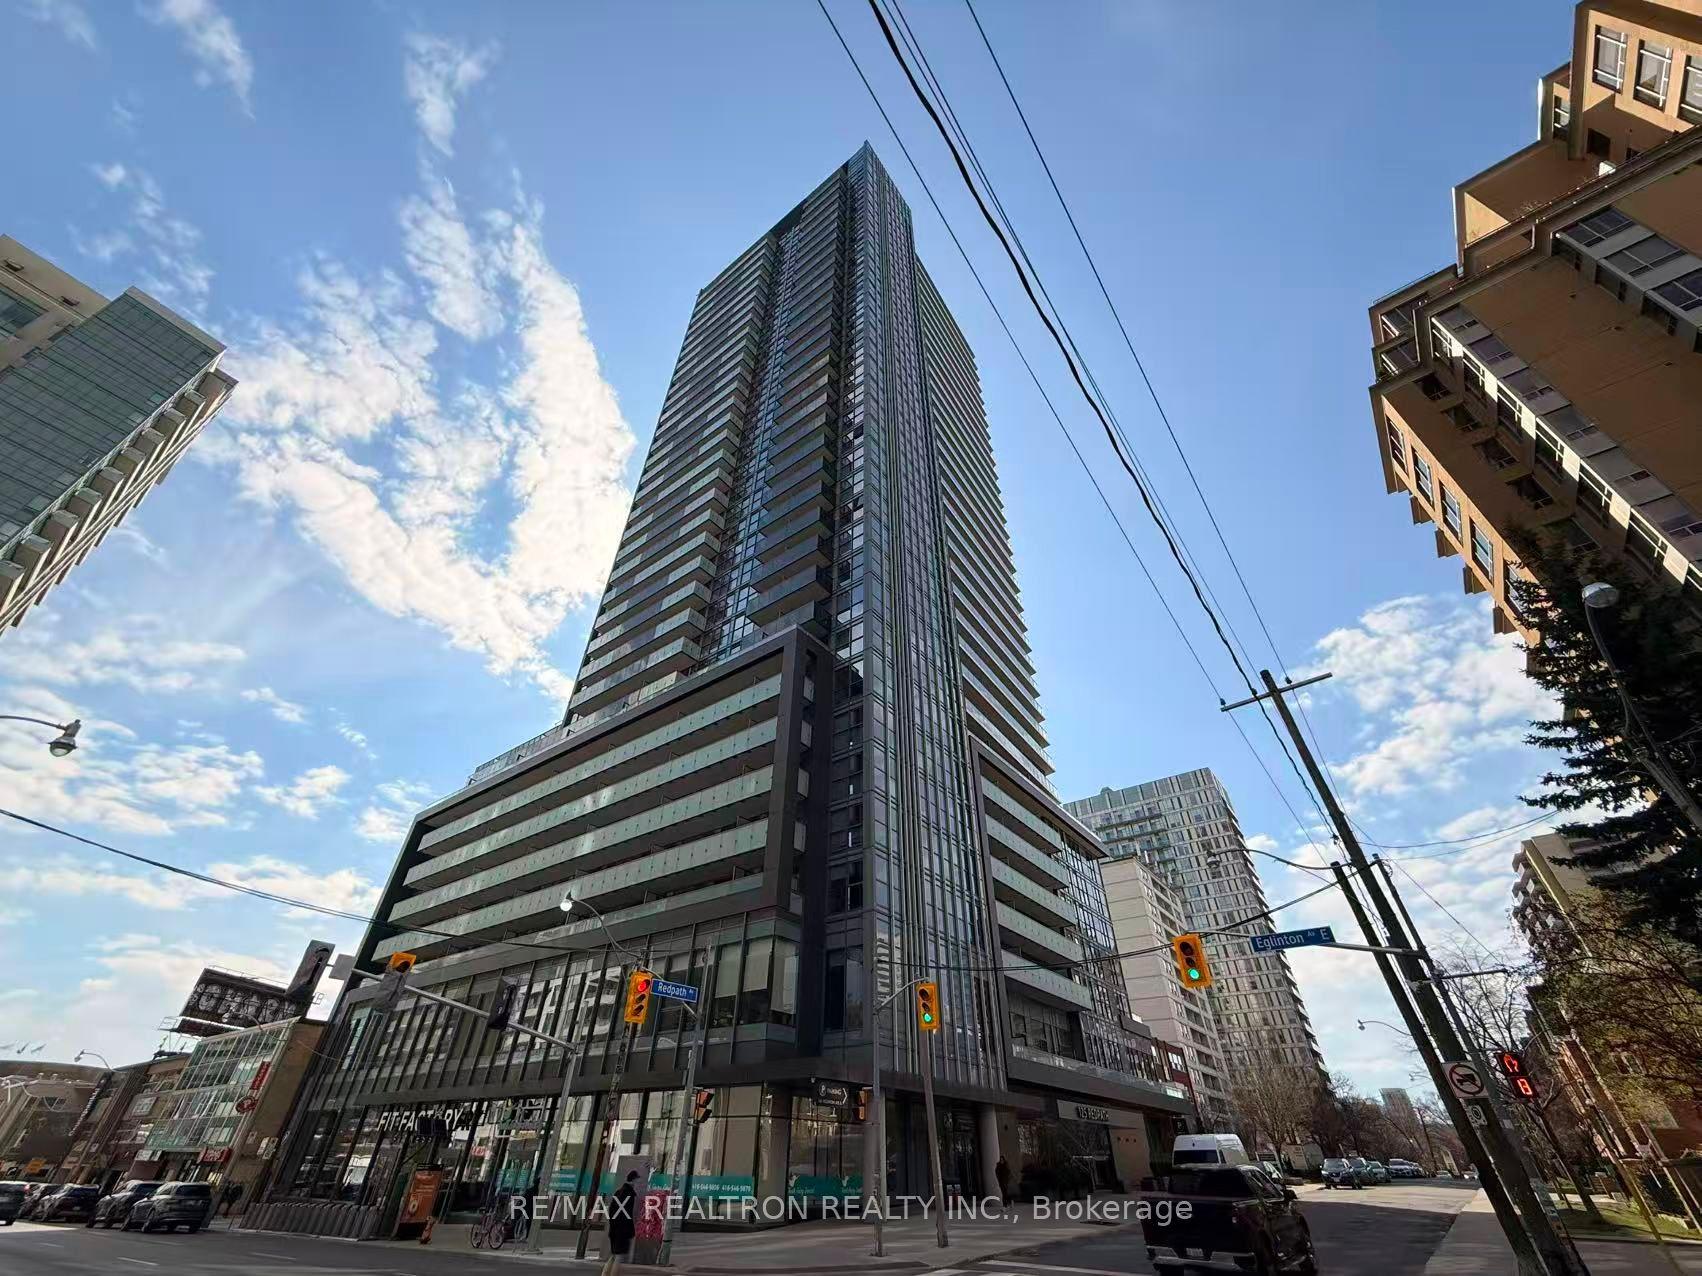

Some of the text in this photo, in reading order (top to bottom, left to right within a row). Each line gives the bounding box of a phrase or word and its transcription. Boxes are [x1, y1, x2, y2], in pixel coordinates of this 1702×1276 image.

[1255, 934, 1305, 950] Eglinton
[1320, 928, 1330, 941] E
[657, 982, 687, 997] Redpath
